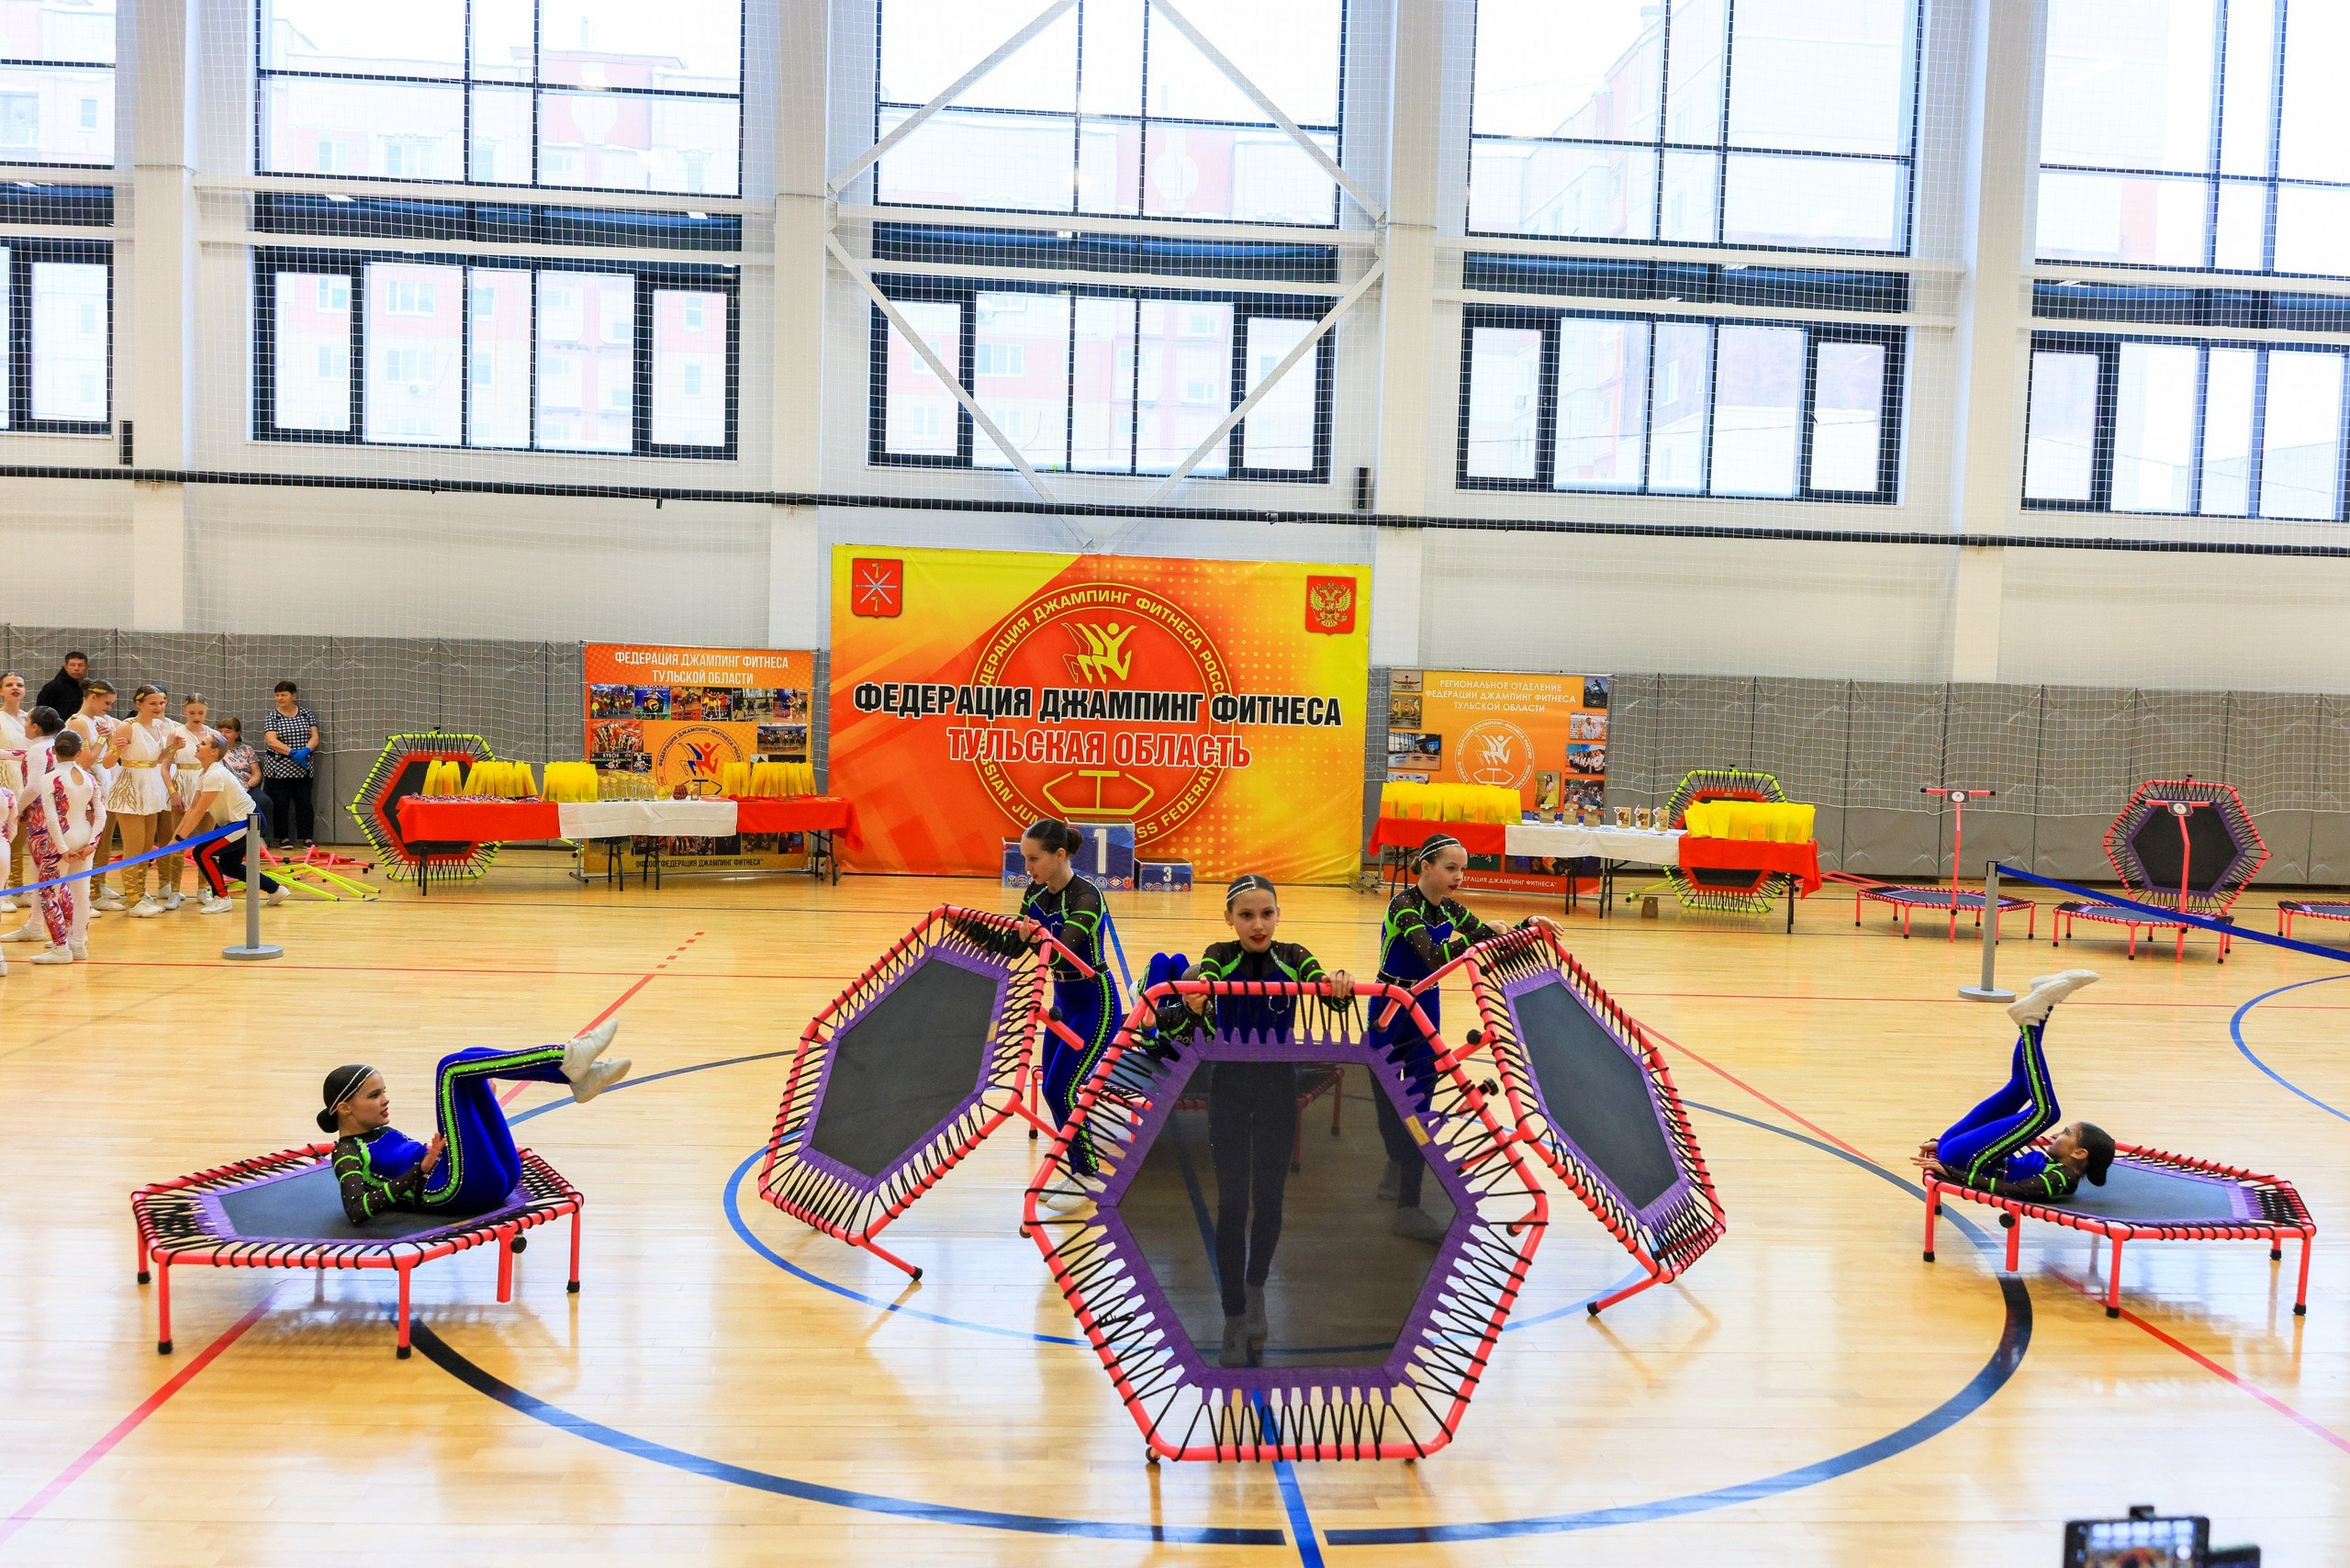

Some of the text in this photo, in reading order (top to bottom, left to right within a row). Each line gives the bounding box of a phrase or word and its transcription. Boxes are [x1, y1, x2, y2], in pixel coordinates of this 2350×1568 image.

[1032, 589, 1132, 623] ДЖАМПИНГ
[1136, 598, 1203, 651] ФИТНЕСА
[614, 651, 789, 669] ФЕДЕРАЦИЯ ДЖАМПИНГ ФИТНЕСА
[652, 669, 754, 685] ТУЛЬСКОЙ ОБЛАСТИ
[1439, 679, 1562, 691] РЕГИОНАЛЬНОЕ ОТДЕЛЕНИЕ
[854, 683, 1342, 726] ФЕДЕРАЦИЯ ДЖАМПИНГ ФИТНЕСА
[1425, 690, 1576, 703] ФЕДЕРАЦИИ ДЖАМПИНГ ФИТНЕСА
[1454, 700, 1545, 712] ТУЛЬСКОЙ ОБЛАСТИ
[658, 735, 678, 767] ФЕДЕРАЦИЯ
[677, 726, 711, 738] ДЖАМПИНГ
[711, 729, 733, 746] ФИТНЕСА
[946, 727, 1252, 768] ТУЛЬСКАЯ ОБЛАСТЬ
[1093, 828, 1107, 874] 1
[698, 858, 733, 868] ДЖАМПИНГ
[1163, 866, 1172, 882] 3
